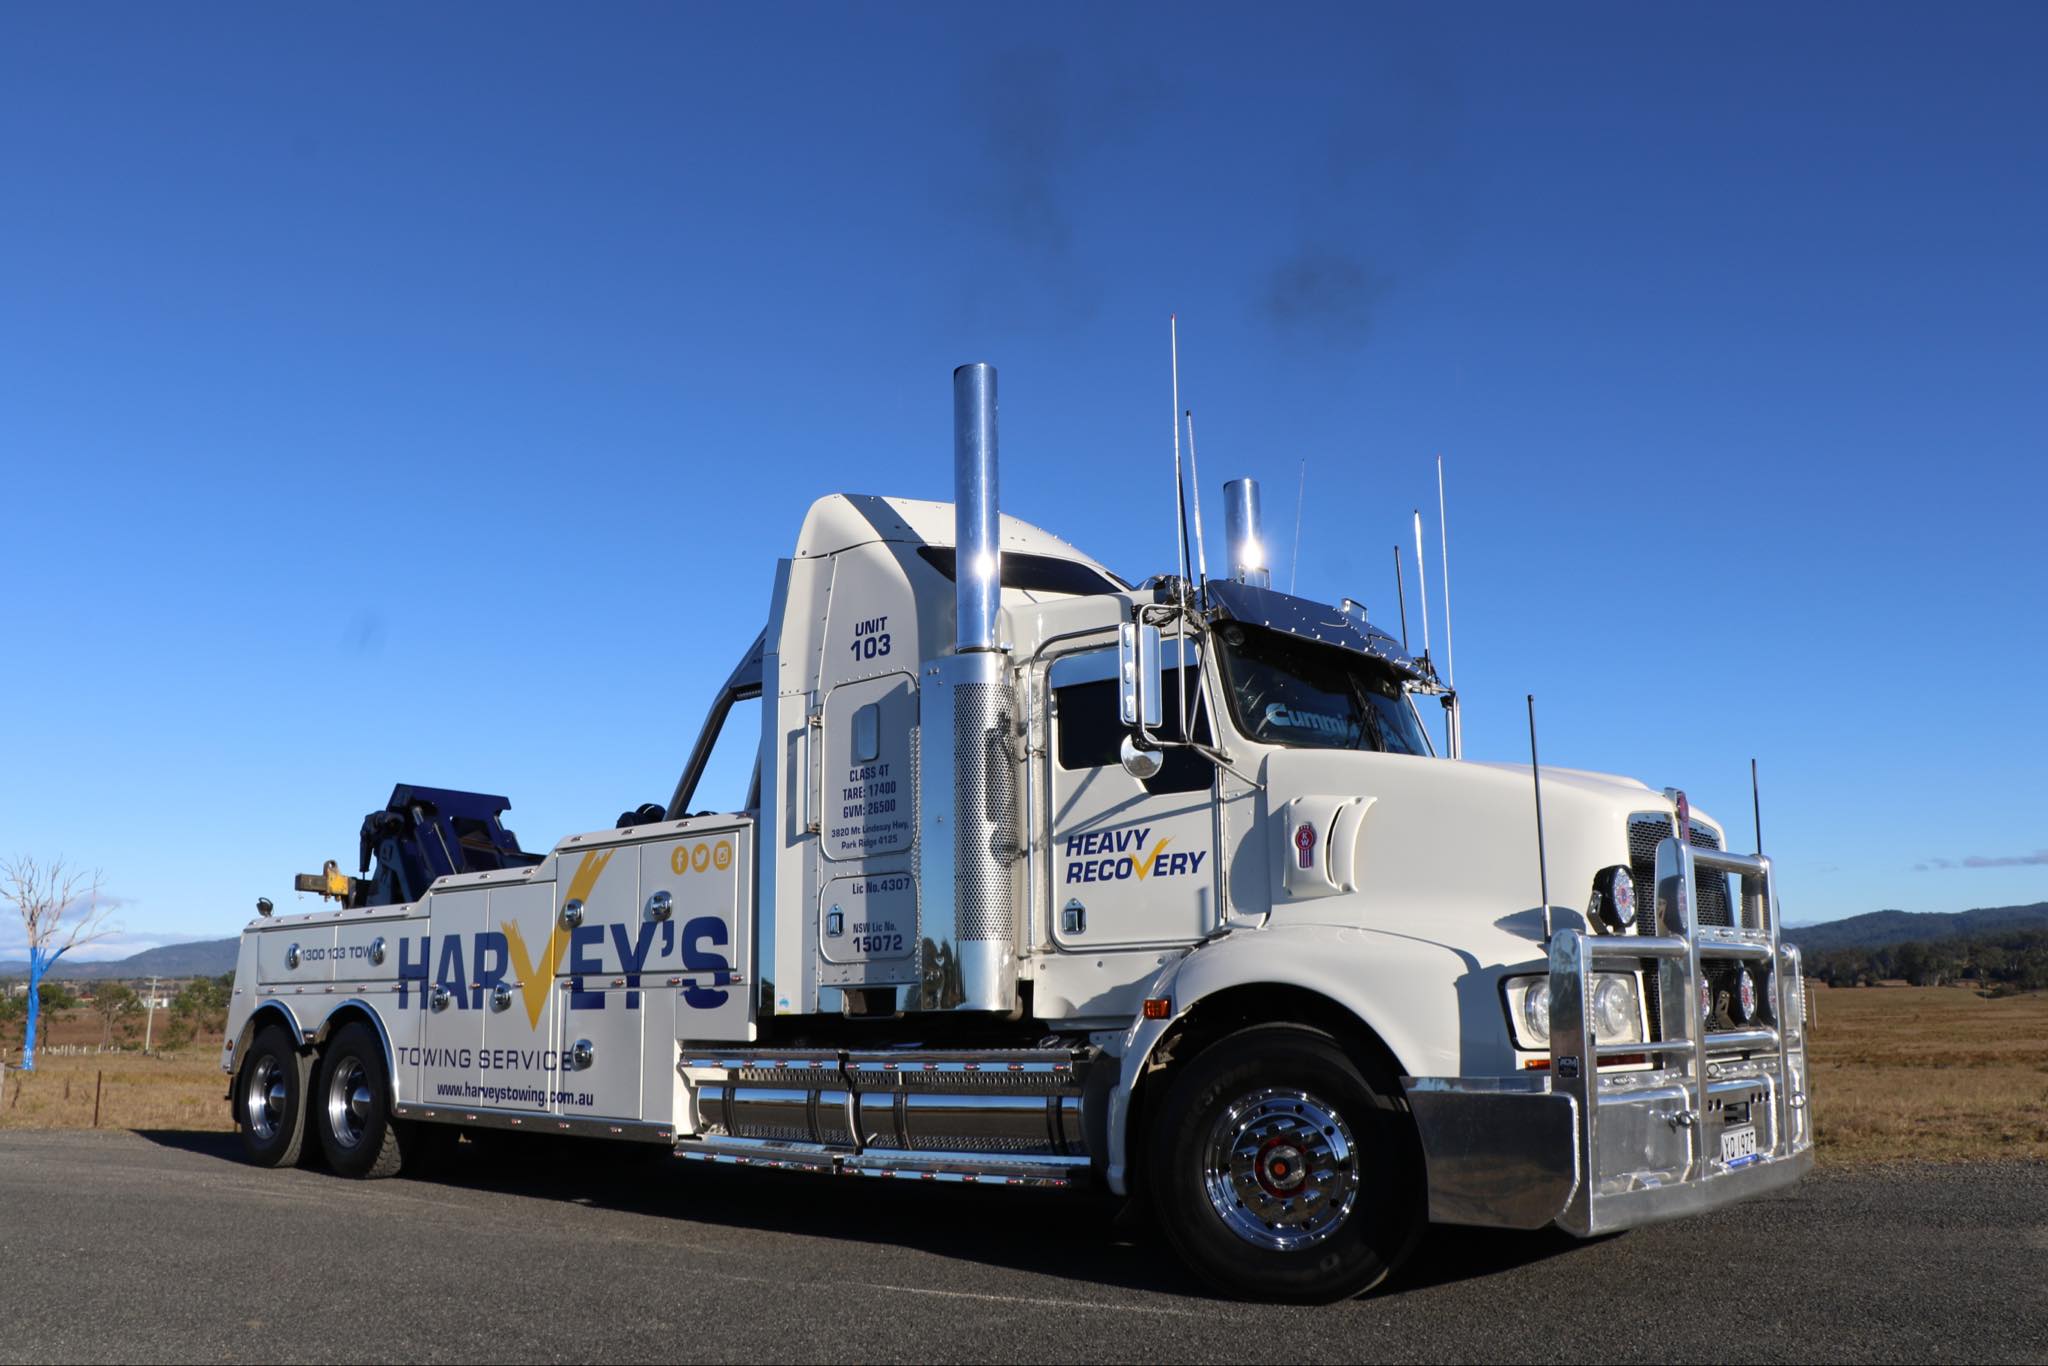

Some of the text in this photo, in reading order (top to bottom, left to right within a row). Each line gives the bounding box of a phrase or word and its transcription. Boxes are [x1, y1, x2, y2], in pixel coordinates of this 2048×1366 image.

[855, 616, 887, 637] UNIT
[850, 634, 891, 662] 103
[850, 764, 889, 782] CLASS 4T
[843, 781, 896, 801] TARE: 17400
[843, 799, 896, 819] GVM: 26500
[832, 828, 850, 838] 3820
[851, 825, 861, 835] Mt
[841, 834, 898, 850] Park Ridge 4125
[1066, 828, 1151, 857] HEAVY
[1066, 835, 1207, 884] RECOVERY
[852, 878, 910, 895] Lic No. 4307
[853, 920, 897, 934] NSW Lic No.
[398, 848, 729, 1032] HARVEY'S
[852, 934, 903, 953] 15072
[301, 948, 325, 961] 1300
[398, 1047, 573, 1072] TOWING SERVICE
[437, 1081, 594, 1108] www.harveystowing.com.au
